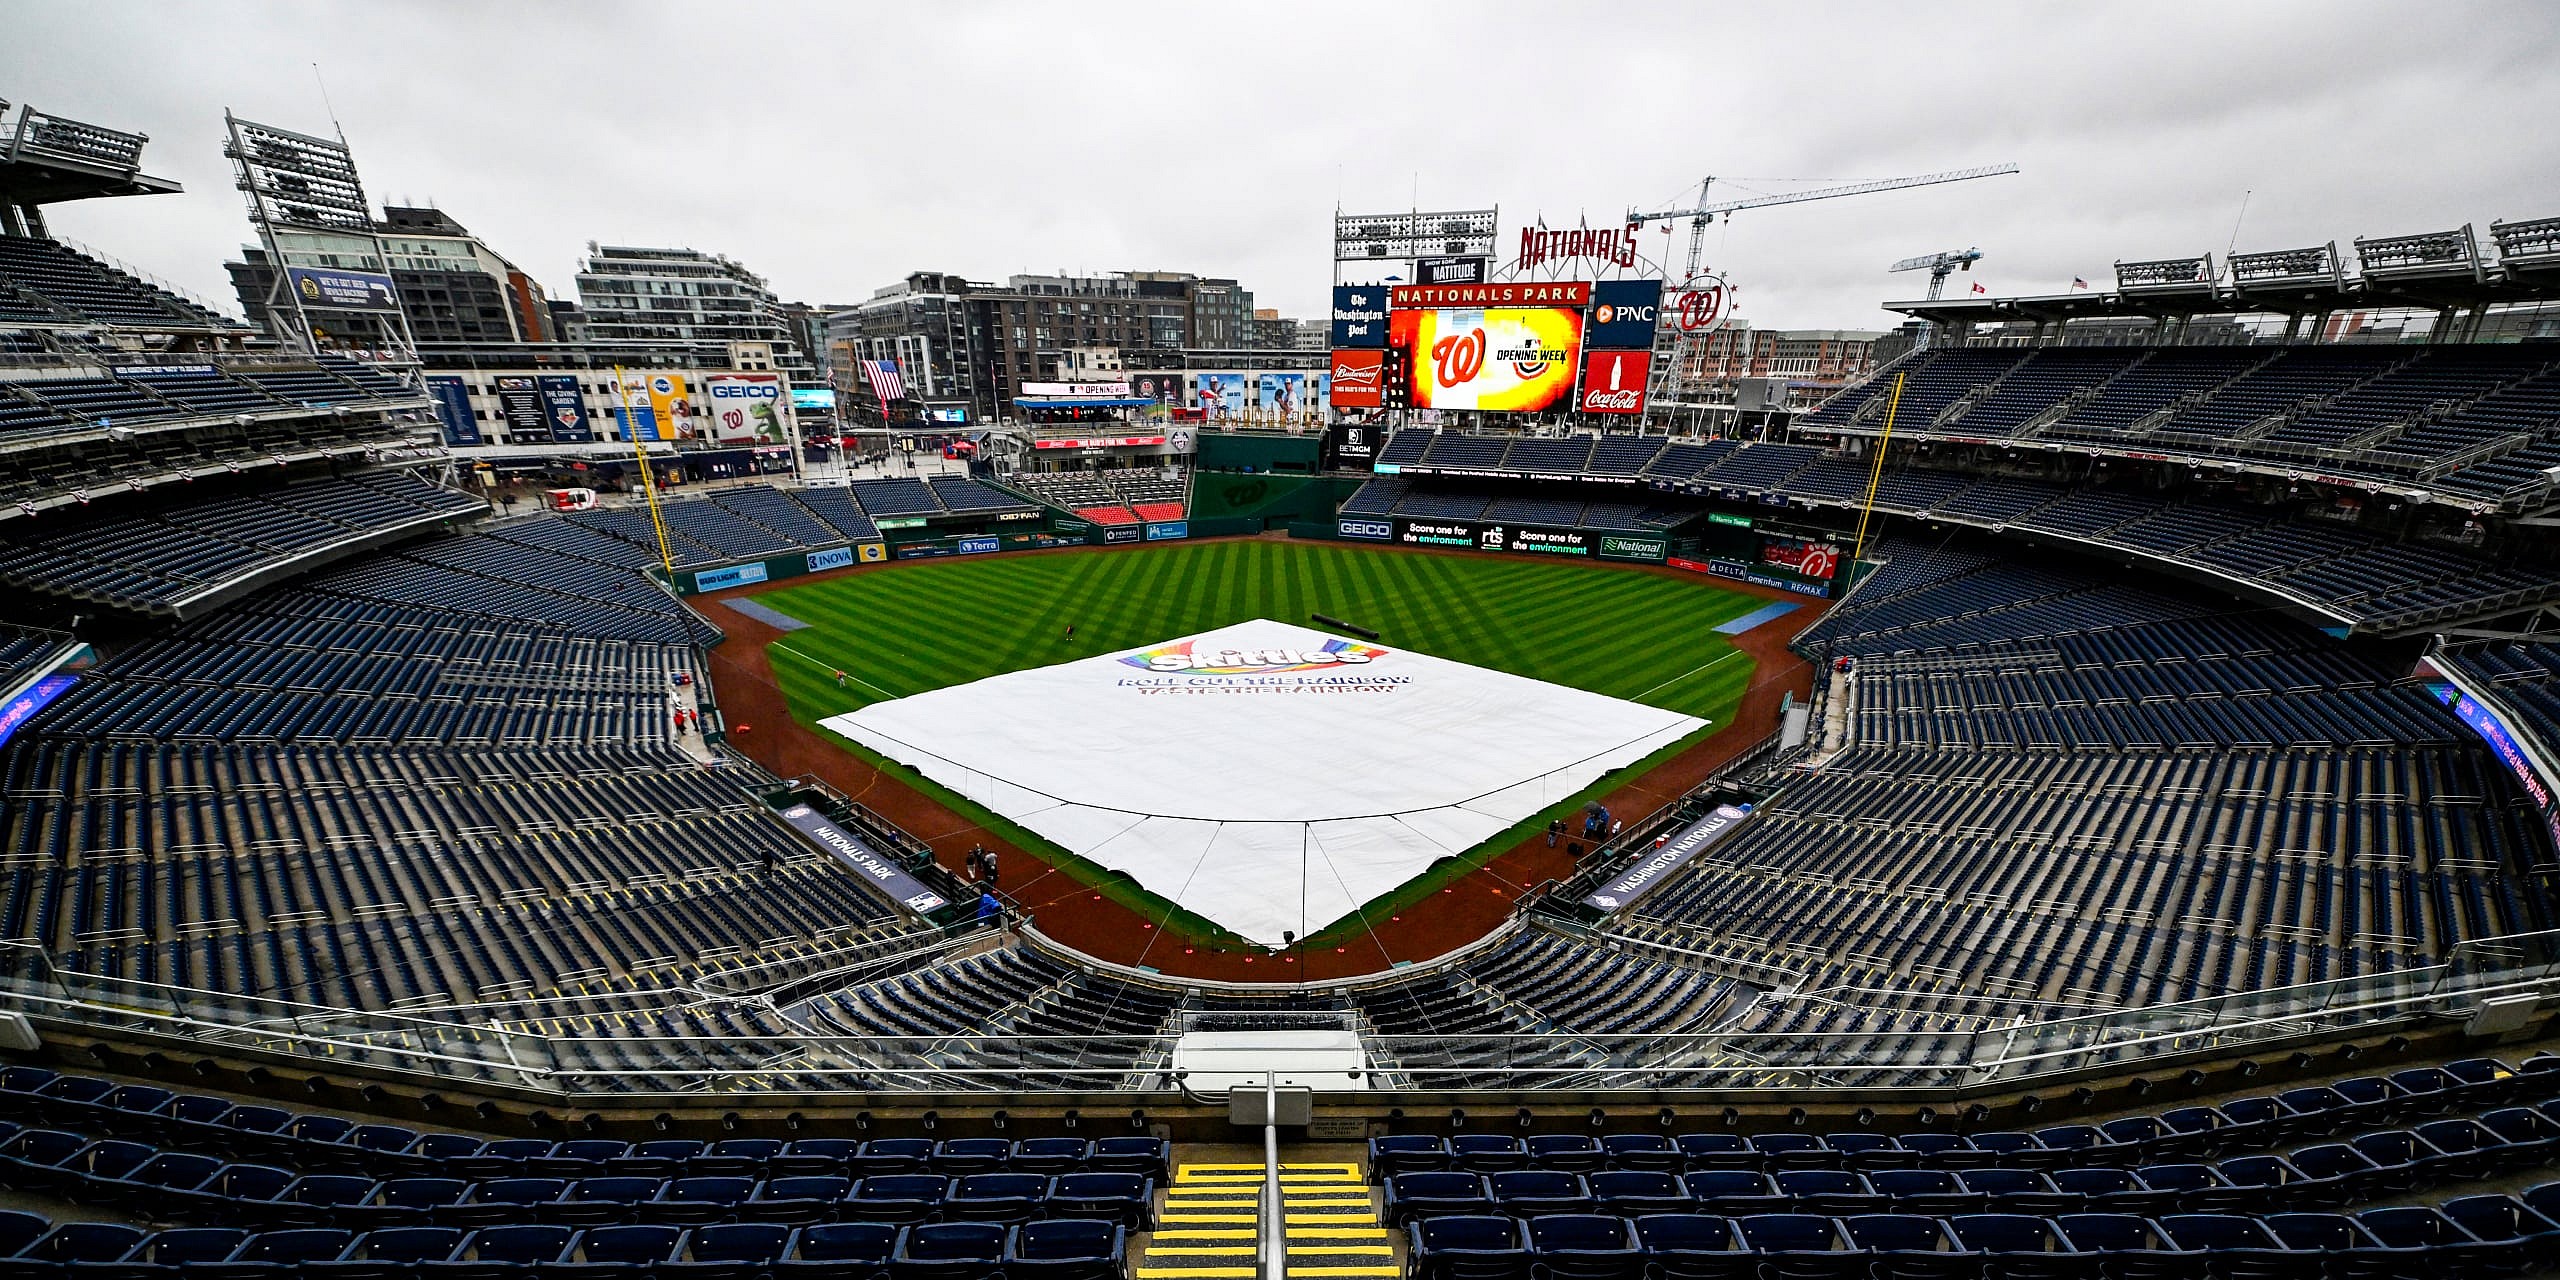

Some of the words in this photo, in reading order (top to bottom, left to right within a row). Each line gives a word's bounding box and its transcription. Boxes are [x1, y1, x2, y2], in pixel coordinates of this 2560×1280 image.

[1519, 223, 1639, 270] NATIONALS
[1432, 263, 1476, 280] NATITUDE
[1351, 295, 1367, 306] The
[1398, 288, 1513, 302] NATIONALS
[1524, 287, 1578, 300] PARK
[1334, 308, 1383, 322] Washington
[1616, 306, 1654, 322] PNC
[1348, 325, 1368, 338] Post
[1497, 350, 1537, 361] OPENING
[1539, 350, 1567, 362] WEEK
[1337, 367, 1376, 378] Budweiser
[712, 385, 779, 398] GEICO
[1085, 385, 1114, 394] OPENING
[1586, 389, 1641, 409] Coca-Cola
[1339, 445, 1371, 453] BETMGM
[1341, 522, 1390, 535] GEICO
[1410, 523, 1434, 533] Score
[1436, 525, 1452, 534] one
[1453, 525, 1467, 536] for
[1403, 533, 1417, 542] the
[1419, 534, 1472, 546] environment
[1482, 529, 1503, 545] rts
[1520, 531, 1547, 541] Score
[1549, 533, 1565, 542] one
[1567, 533, 1582, 544] for
[972, 542, 997, 550] Terra
[1513, 541, 1528, 550] the
[1529, 543, 1587, 555] environment
[1616, 540, 1661, 553] National
[819, 551, 851, 566] INOVA
[1718, 565, 1744, 576] DELTA
[717, 573, 740, 583] LIGHT
[1791, 583, 1822, 596] RE/MAX
[1146, 649, 1373, 671] Skittles
[1118, 678, 1182, 686] ROLL
[1188, 677, 1240, 686] OUT
[1243, 677, 1293, 686] THE
[1298, 676, 1415, 685] RAINBOW
[1137, 687, 1216, 695] TASTE
[1223, 686, 1271, 695] THE
[1274, 686, 1399, 695] RAINBOW
[813, 826, 870, 862] NATIONALS
[861, 859, 896, 881] PARK
[1613, 848, 1683, 894] WASHINGTON
[1678, 817, 1728, 854] NATIONALS
